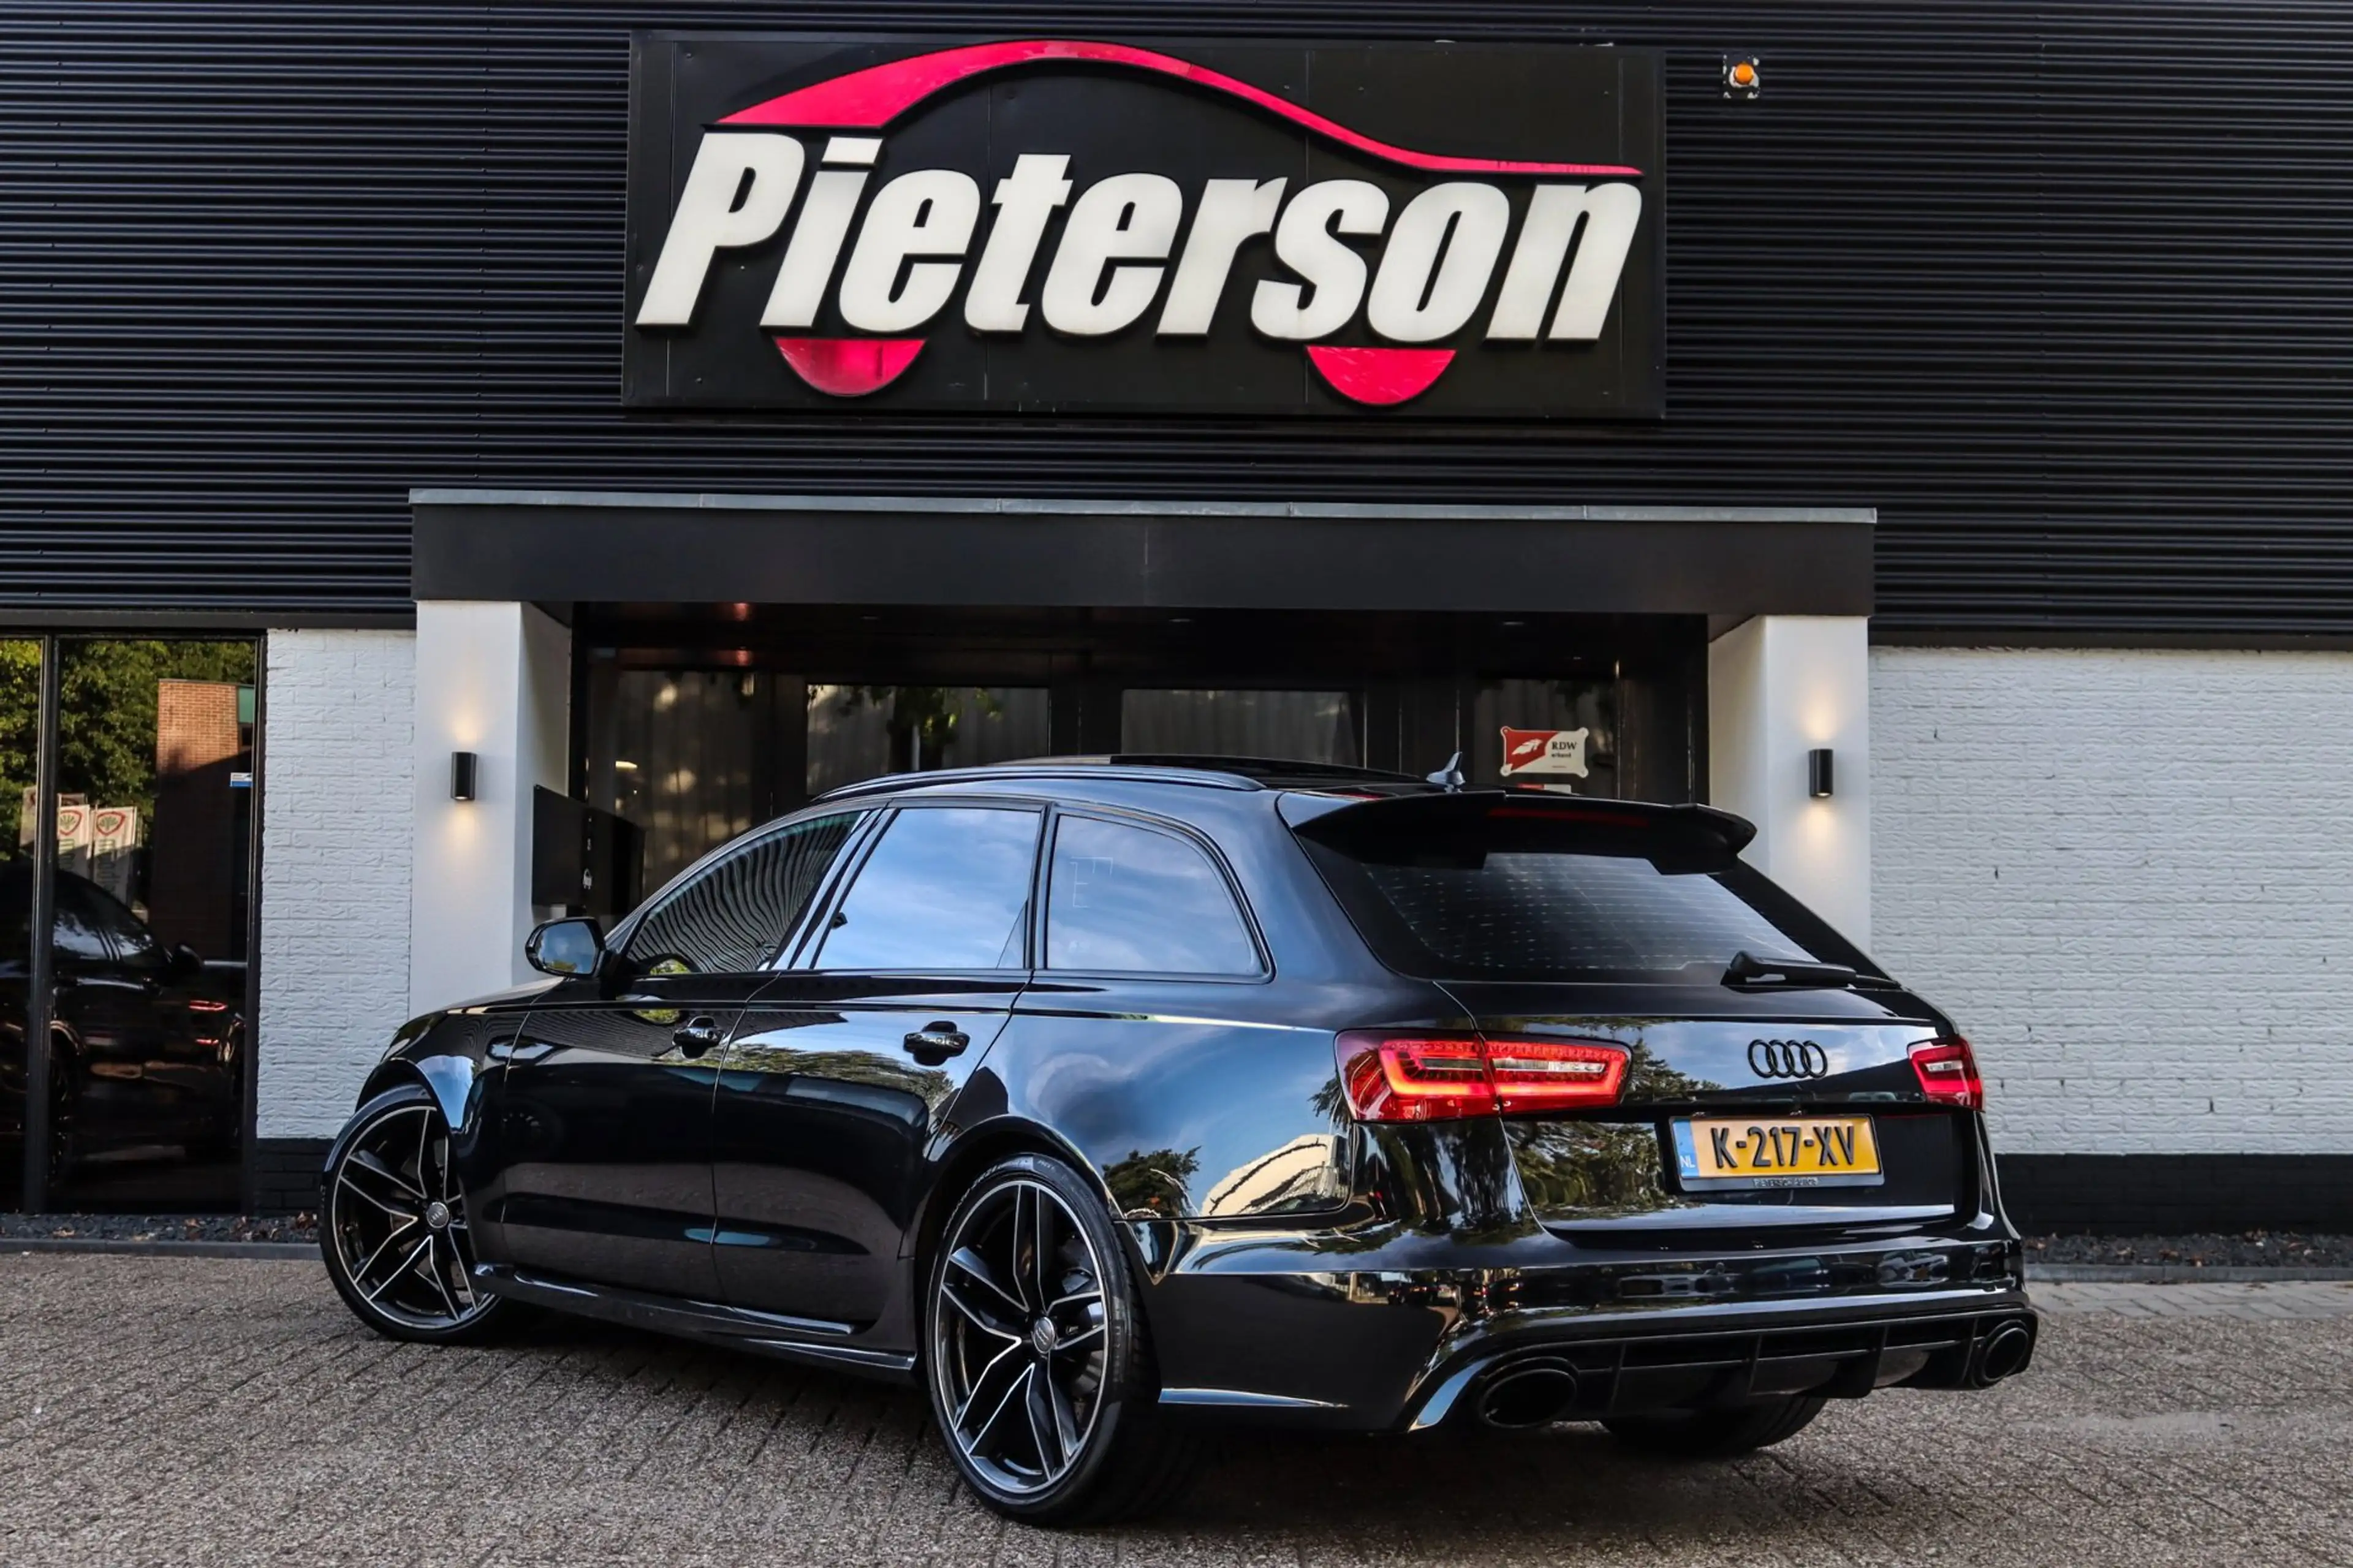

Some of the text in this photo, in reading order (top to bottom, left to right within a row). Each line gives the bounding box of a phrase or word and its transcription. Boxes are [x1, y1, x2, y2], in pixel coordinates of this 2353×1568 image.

[635, 133, 1642, 341] Pieterson
[1552, 741, 1577, 750] RDW
[1711, 1126, 1855, 1168] K-217-XV
[1680, 1155, 1696, 1168] NL
